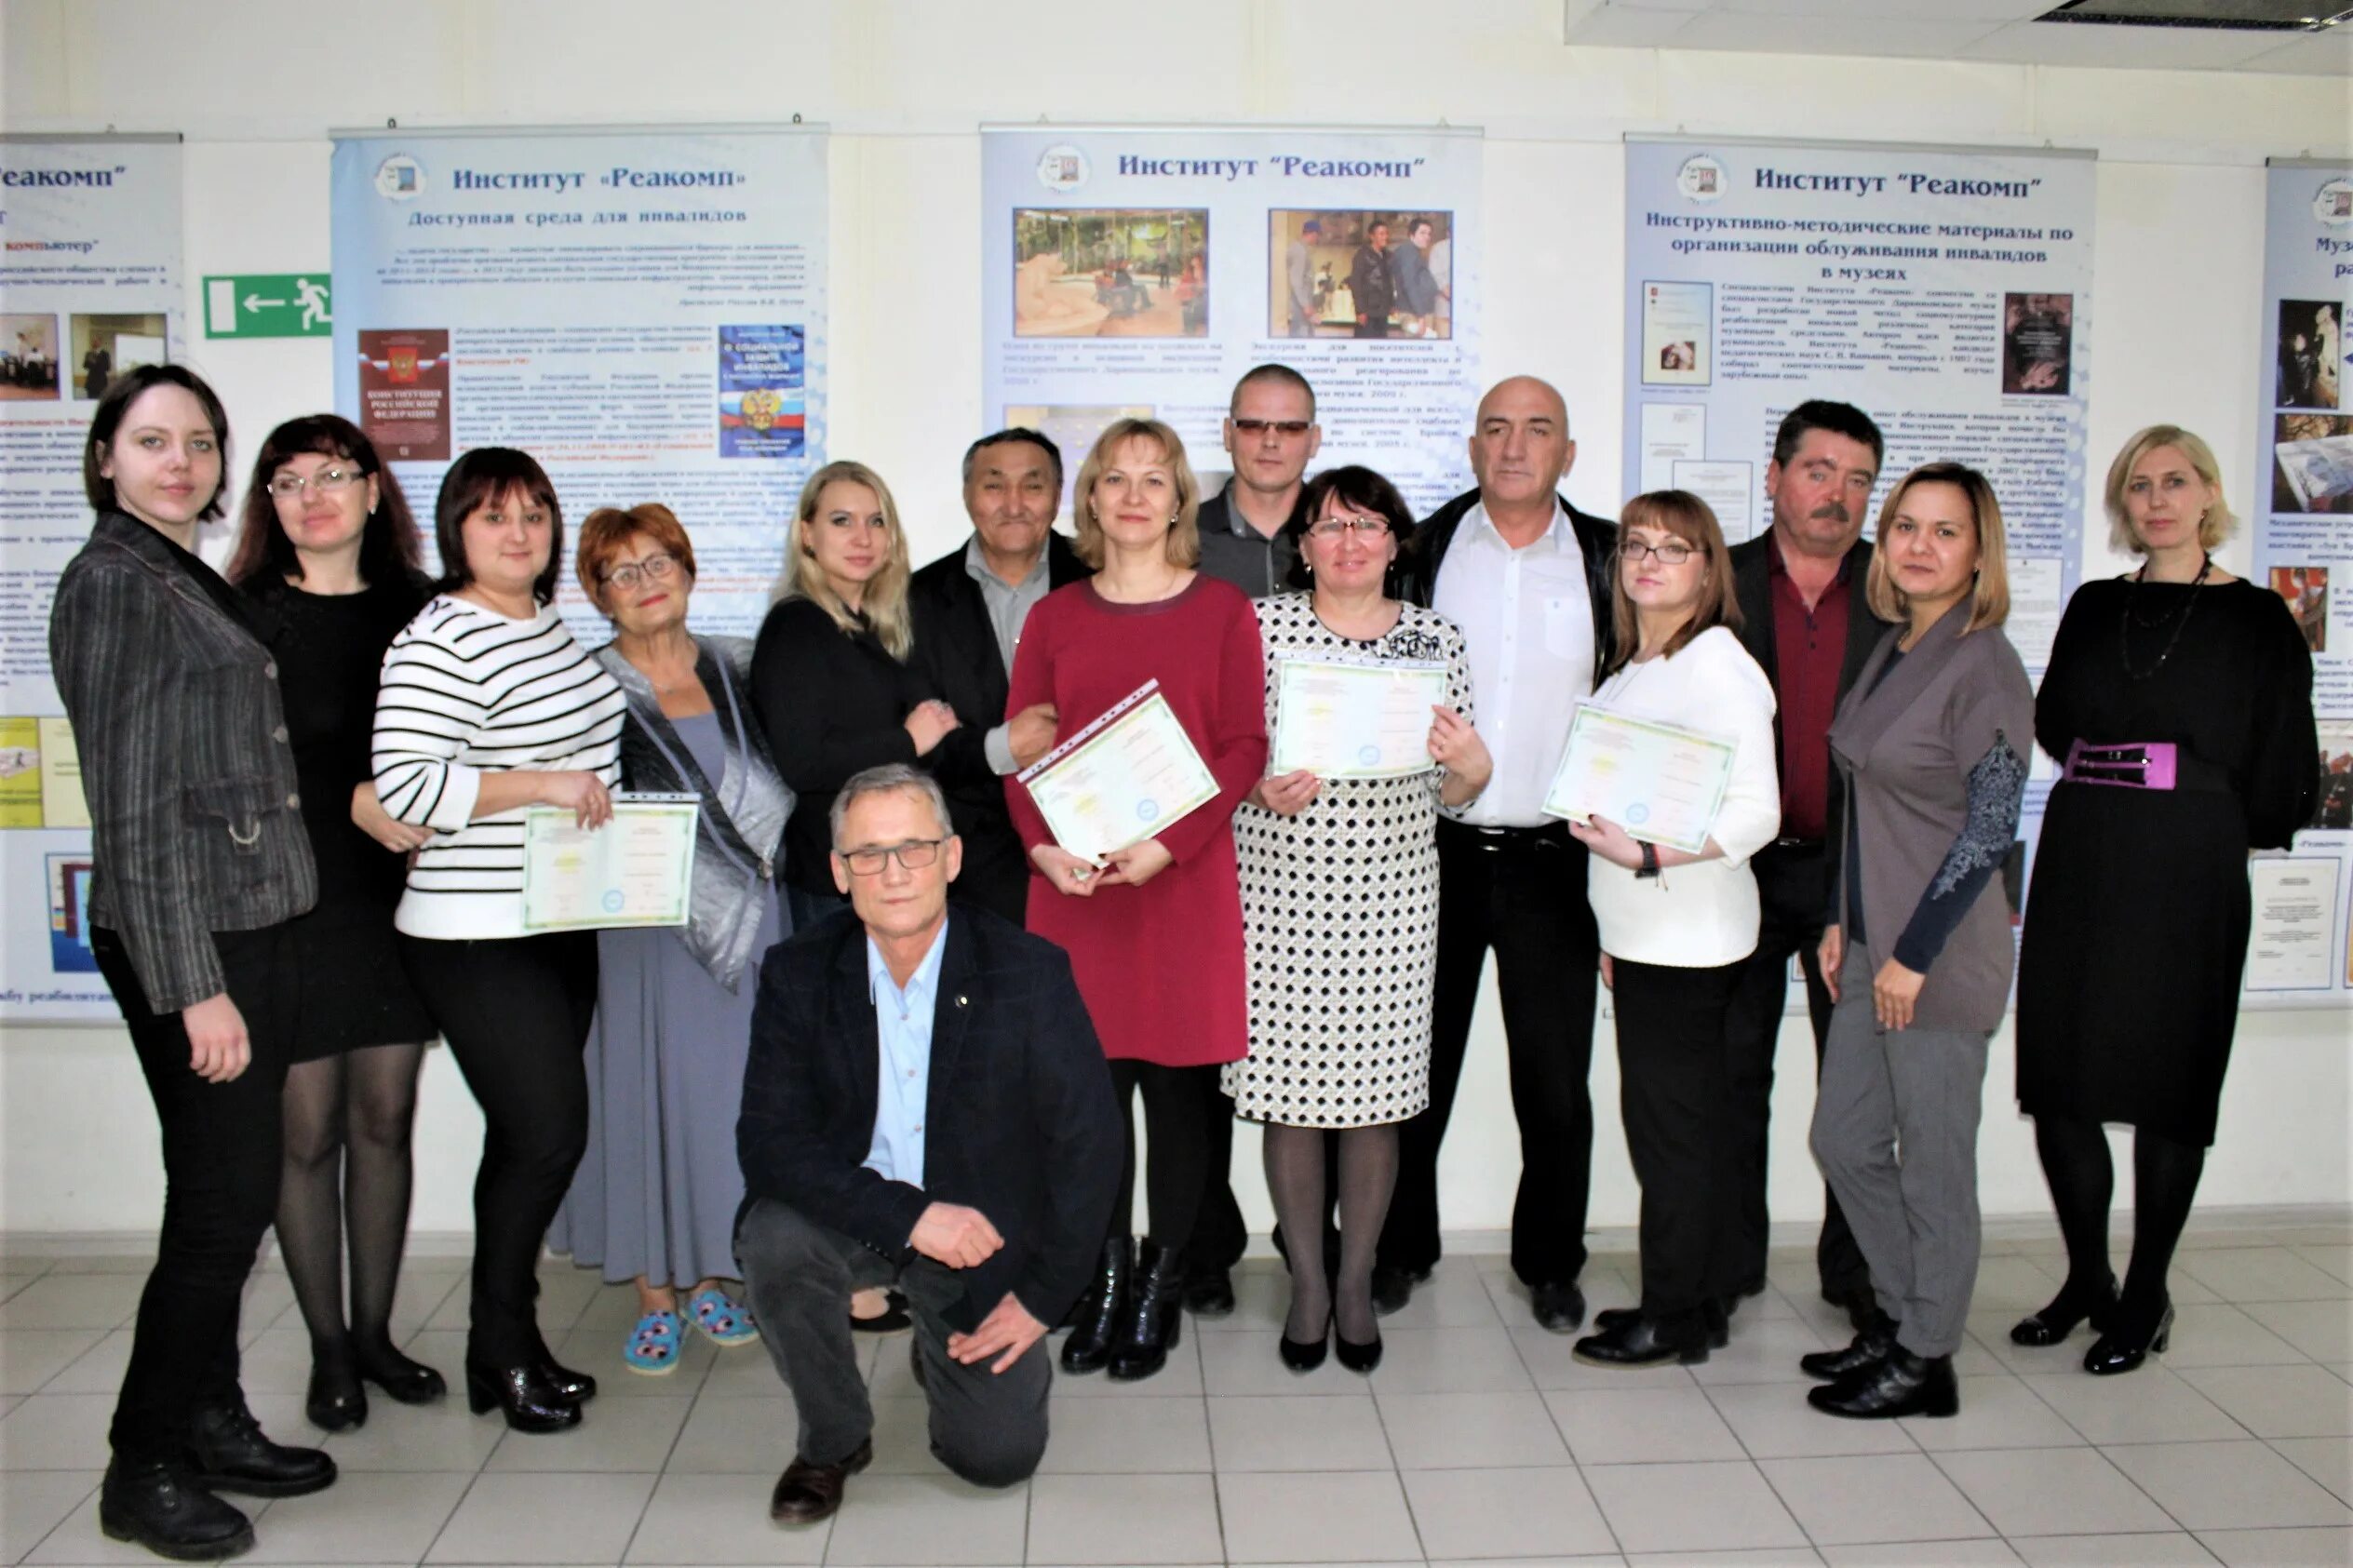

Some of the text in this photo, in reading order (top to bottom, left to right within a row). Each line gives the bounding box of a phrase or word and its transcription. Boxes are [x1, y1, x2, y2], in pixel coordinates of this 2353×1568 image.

[0, 165, 128, 188] еакомп"
[452, 166, 746, 193] Институт «Реакомп»
[1119, 154, 1426, 181] Институт "Реакомп"
[1755, 167, 2042, 200] Институт "Реакомп"
[408, 209, 747, 228] Доступная среда для инвалидов
[1645, 211, 2074, 242] Инструктивно-методические материалы по
[5, 239, 100, 255] компьютер"
[1671, 237, 1799, 257] организации
[1945, 248, 2048, 263] инвалидов
[1821, 267, 1907, 283] в музеях
[2334, 264, 2353, 279] ра
